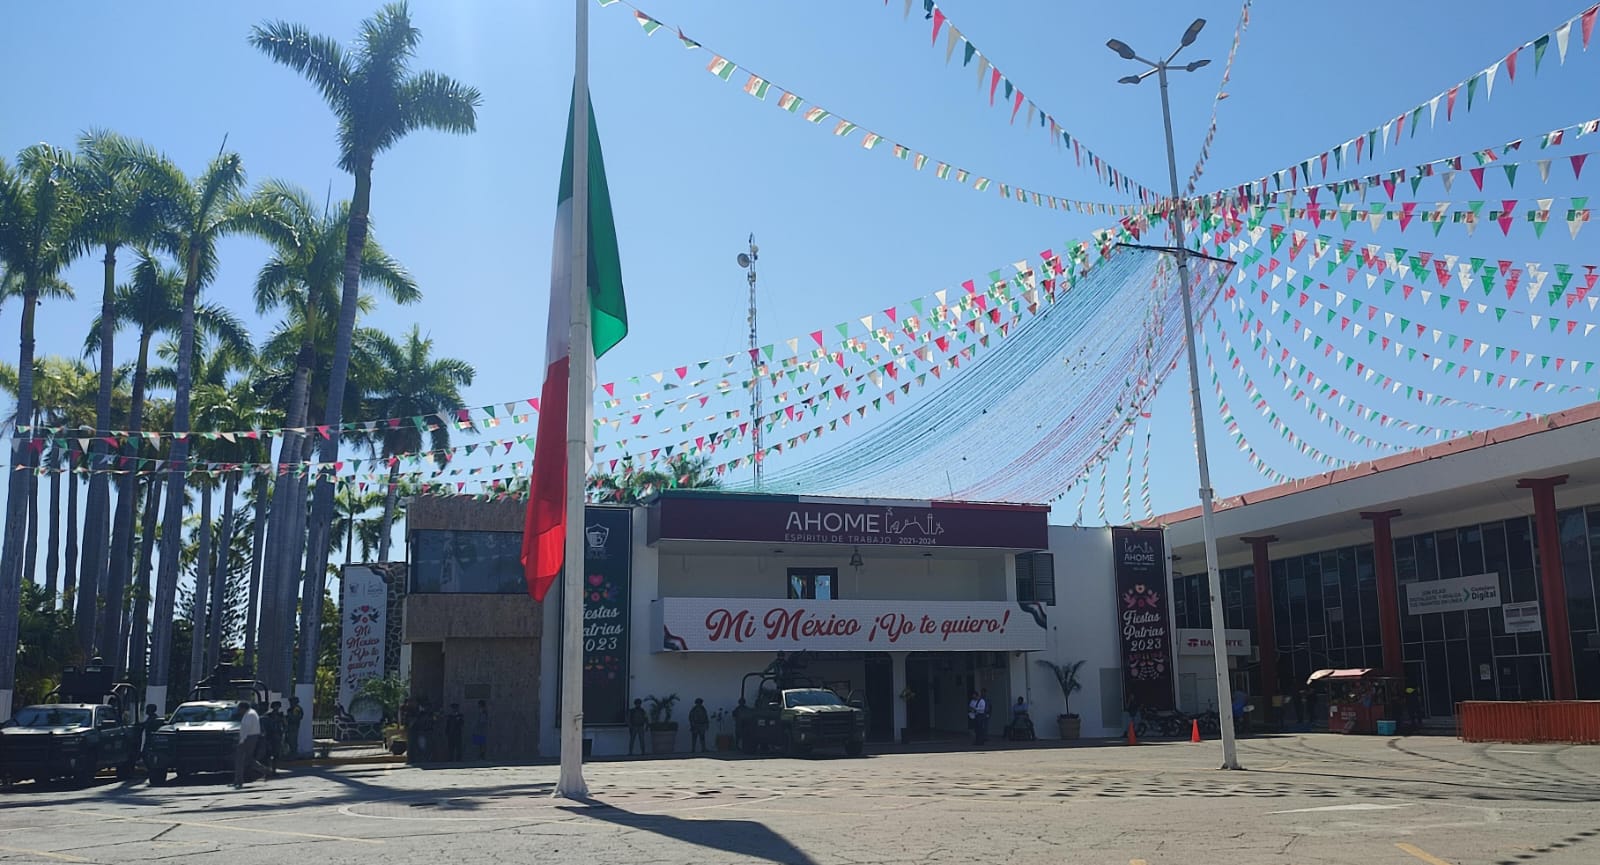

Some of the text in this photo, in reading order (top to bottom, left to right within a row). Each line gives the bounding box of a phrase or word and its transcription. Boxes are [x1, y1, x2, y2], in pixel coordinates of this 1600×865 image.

[785, 511, 880, 533] AHOME
[831, 535, 844, 543] DE
[848, 535, 892, 544] TRABAJO
[899, 537, 937, 545] 2021-2024
[1124, 553, 1155, 562] AHOME
[1471, 590, 1497, 601] Digital
[1123, 610, 1160, 625] Fiestas
[583, 623, 624, 637] atrias
[705, 607, 1011, 643] Mi México ¡Yo te quiero!
[1123, 625, 1166, 641] Patrias
[583, 638, 617, 652] 023
[1130, 638, 1162, 652] 2023
